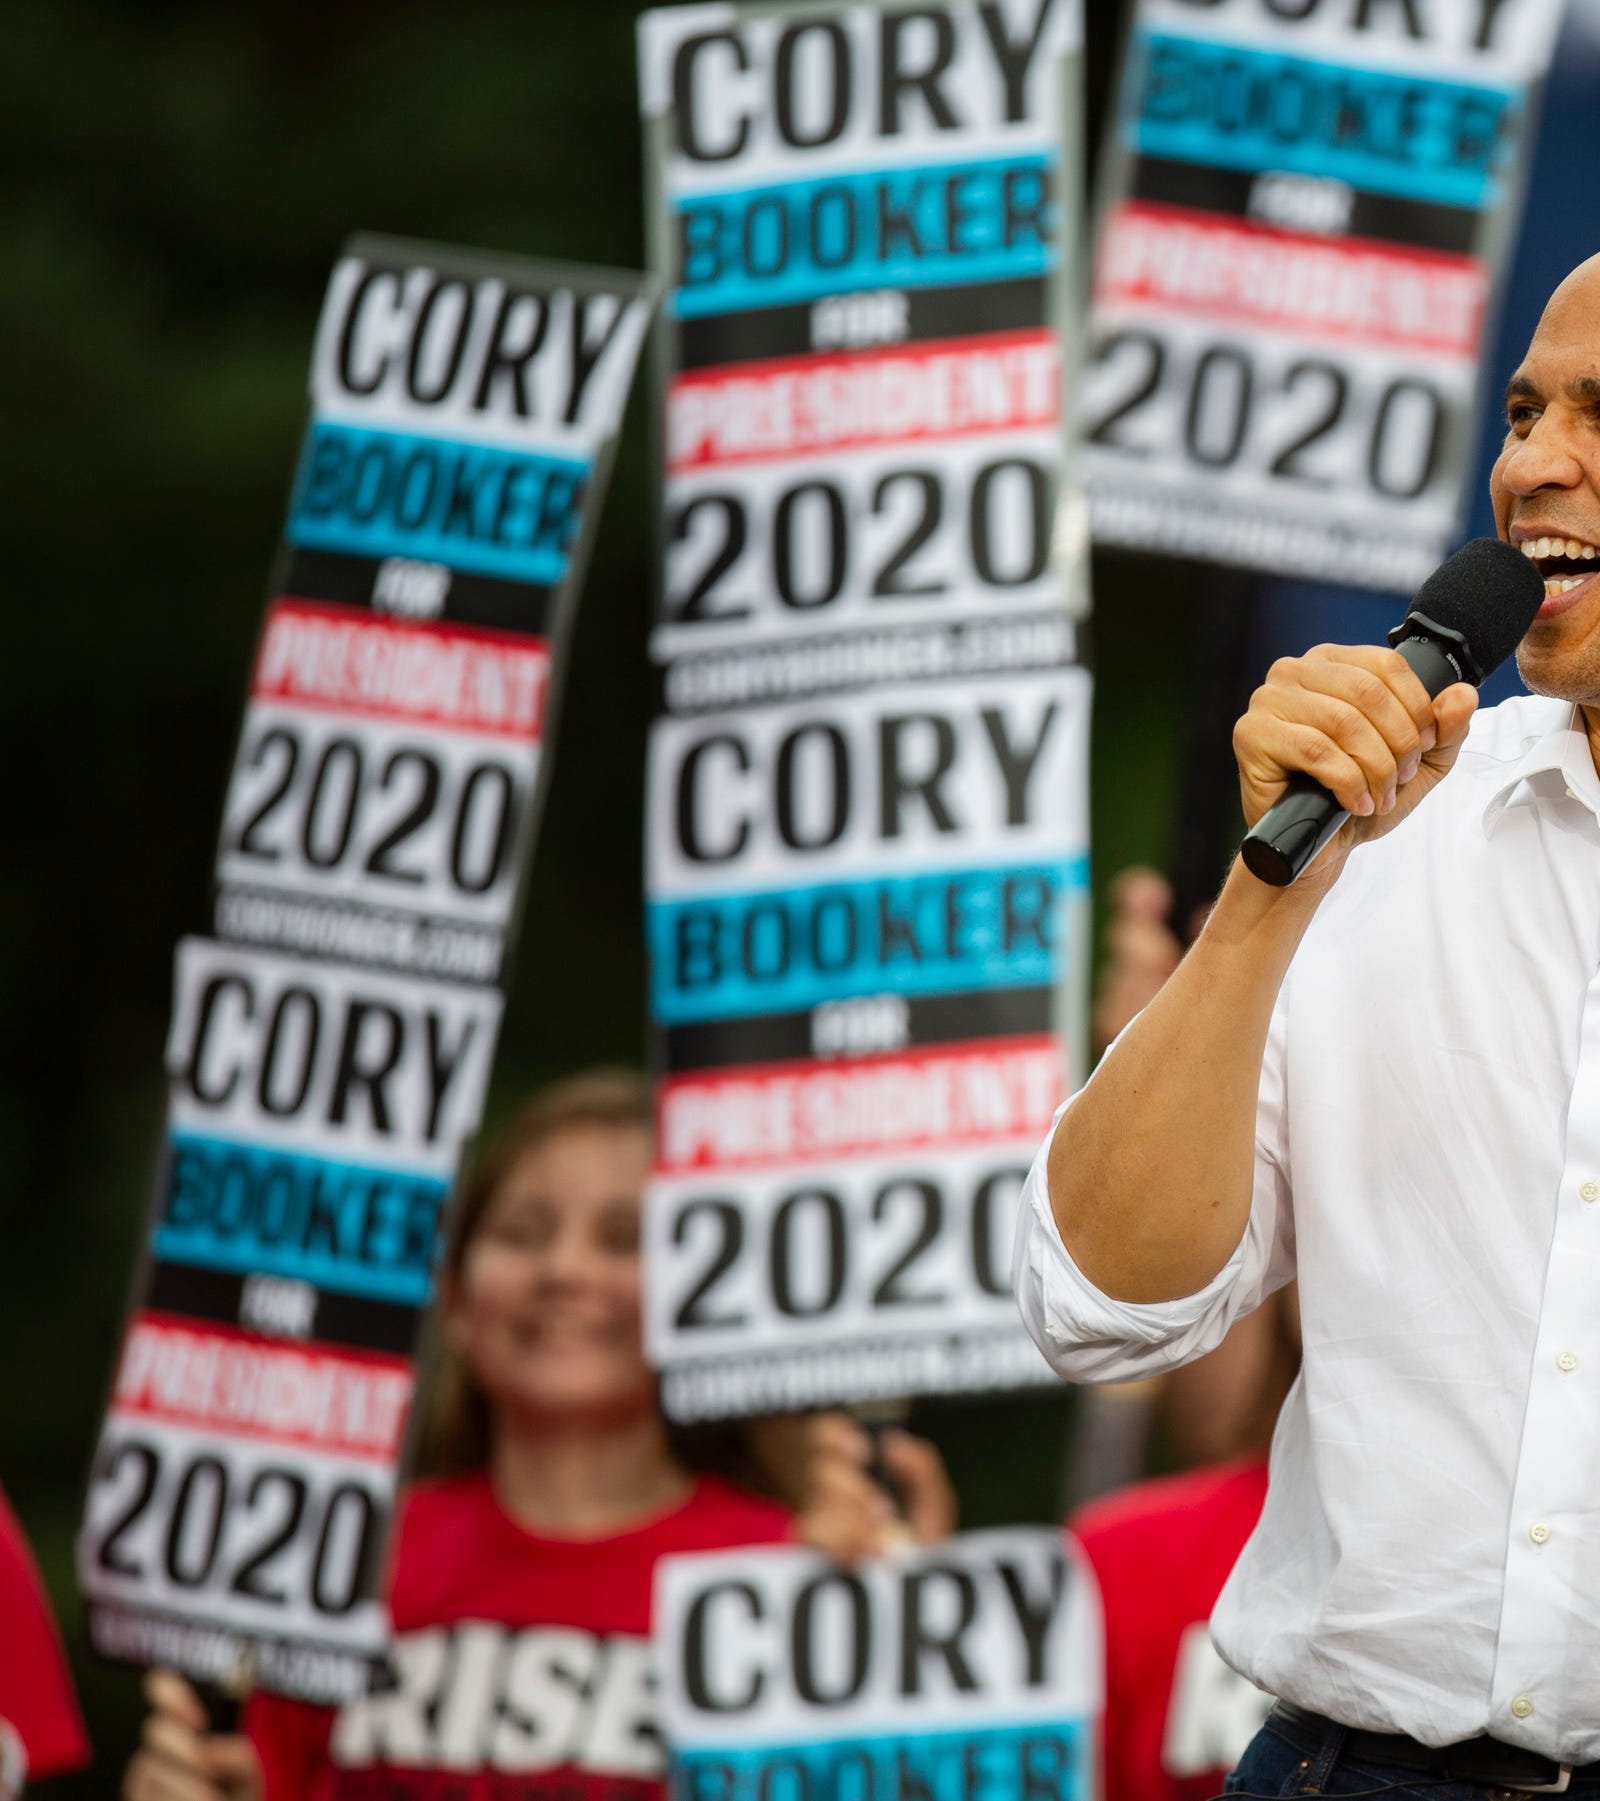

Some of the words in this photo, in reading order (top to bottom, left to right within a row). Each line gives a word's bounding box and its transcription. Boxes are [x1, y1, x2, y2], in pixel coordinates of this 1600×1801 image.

[673, 0, 1058, 163] CORY
[679, 168, 1054, 287] BOOKER
[337, 270, 638, 426] CORY
[1086, 329, 1448, 500] 2020
[311, 428, 580, 553] BOOKER
[673, 458, 1050, 622] 2020
[239, 728, 516, 896] 2020
[675, 698, 1059, 866] CORY
[675, 874, 1054, 992] BOOKER
[184, 968, 478, 1145] CORY
[165, 1138, 446, 1268] BOOKER
[98, 1438, 381, 1617] 2020
[682, 1557, 1068, 1715] CORY
